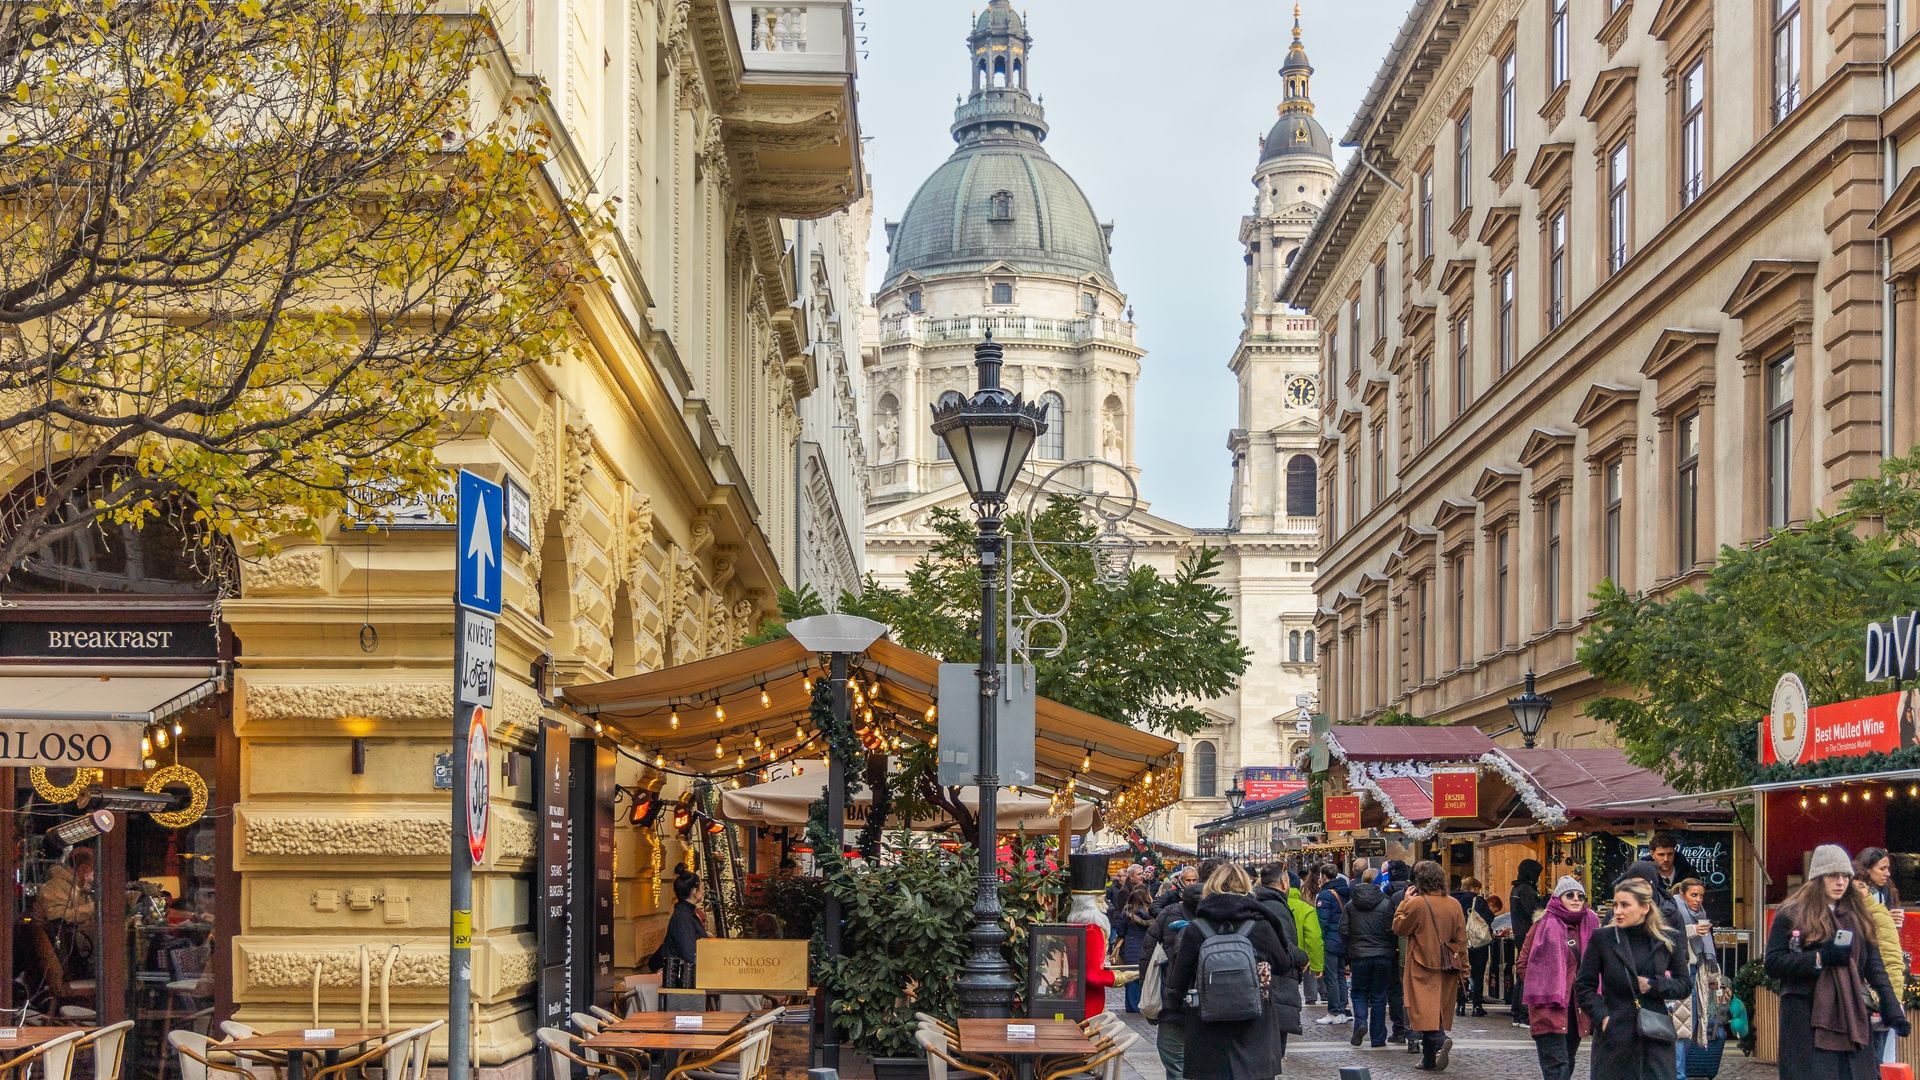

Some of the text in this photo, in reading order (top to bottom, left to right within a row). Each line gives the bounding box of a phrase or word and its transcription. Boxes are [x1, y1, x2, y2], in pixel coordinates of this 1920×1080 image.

[467, 620, 493, 648] KIVÉVE
[1296, 694, 1312, 734] BAR
[1815, 718, 1884, 743] Best Mulled Wine
[1829, 743, 1837, 752] The
[1837, 741, 1857, 751] Christmas
[1857, 739, 1872, 748] Market
[472, 758, 485, 816] 30
[1444, 793, 1465, 801] ÉKSZER
[1444, 801, 1467, 809] JEWELRY
[1024, 812, 1035, 820] BY
[550, 865, 563, 876] STEAKS
[549, 885, 564, 896] BURGERS
[550, 905, 563, 917] SALADS
[723, 956, 781, 967] NONLOSO
